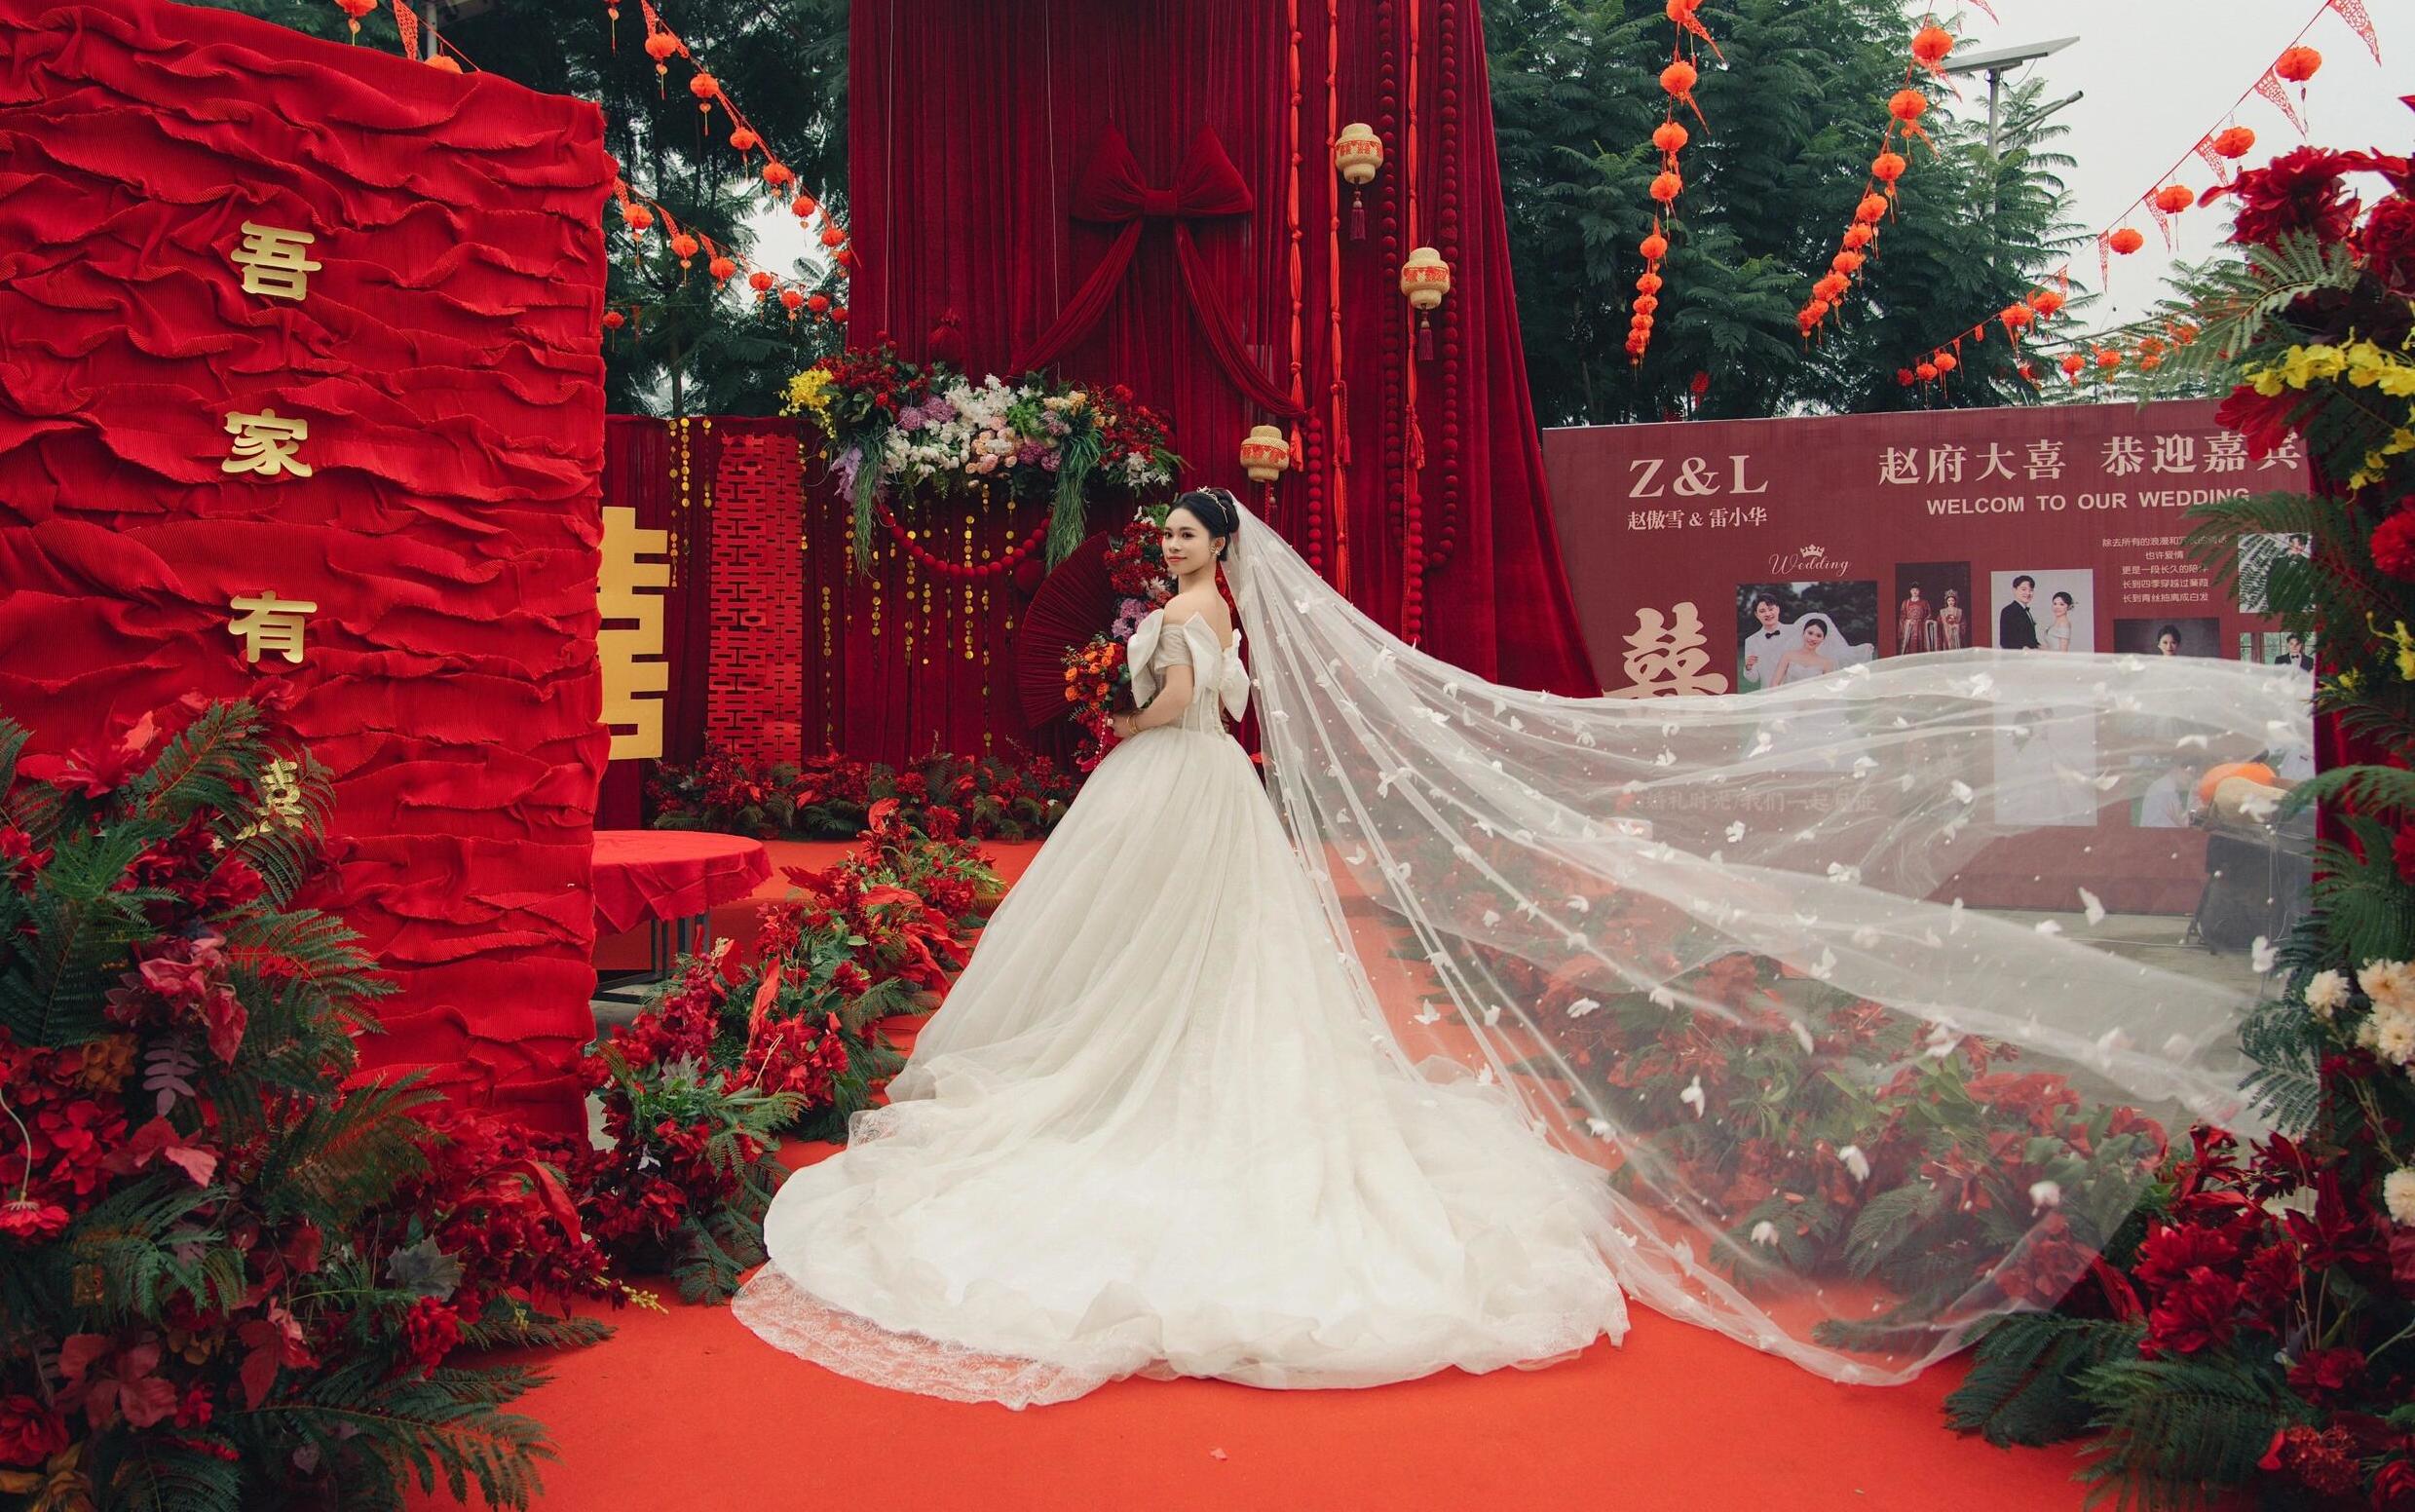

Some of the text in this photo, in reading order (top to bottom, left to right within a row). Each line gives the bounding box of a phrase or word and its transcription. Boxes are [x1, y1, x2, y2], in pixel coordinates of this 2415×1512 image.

[1878, 438, 2066, 486] 赵府大喜
[1926, 487, 2250, 515] WELCOM TO OUR WEDDING
[1627, 507, 1768, 531] 赵傲雪 & 雷小华
[1768, 552, 1851, 577] Wedding
[2145, 550, 2184, 560] 也许爱情
